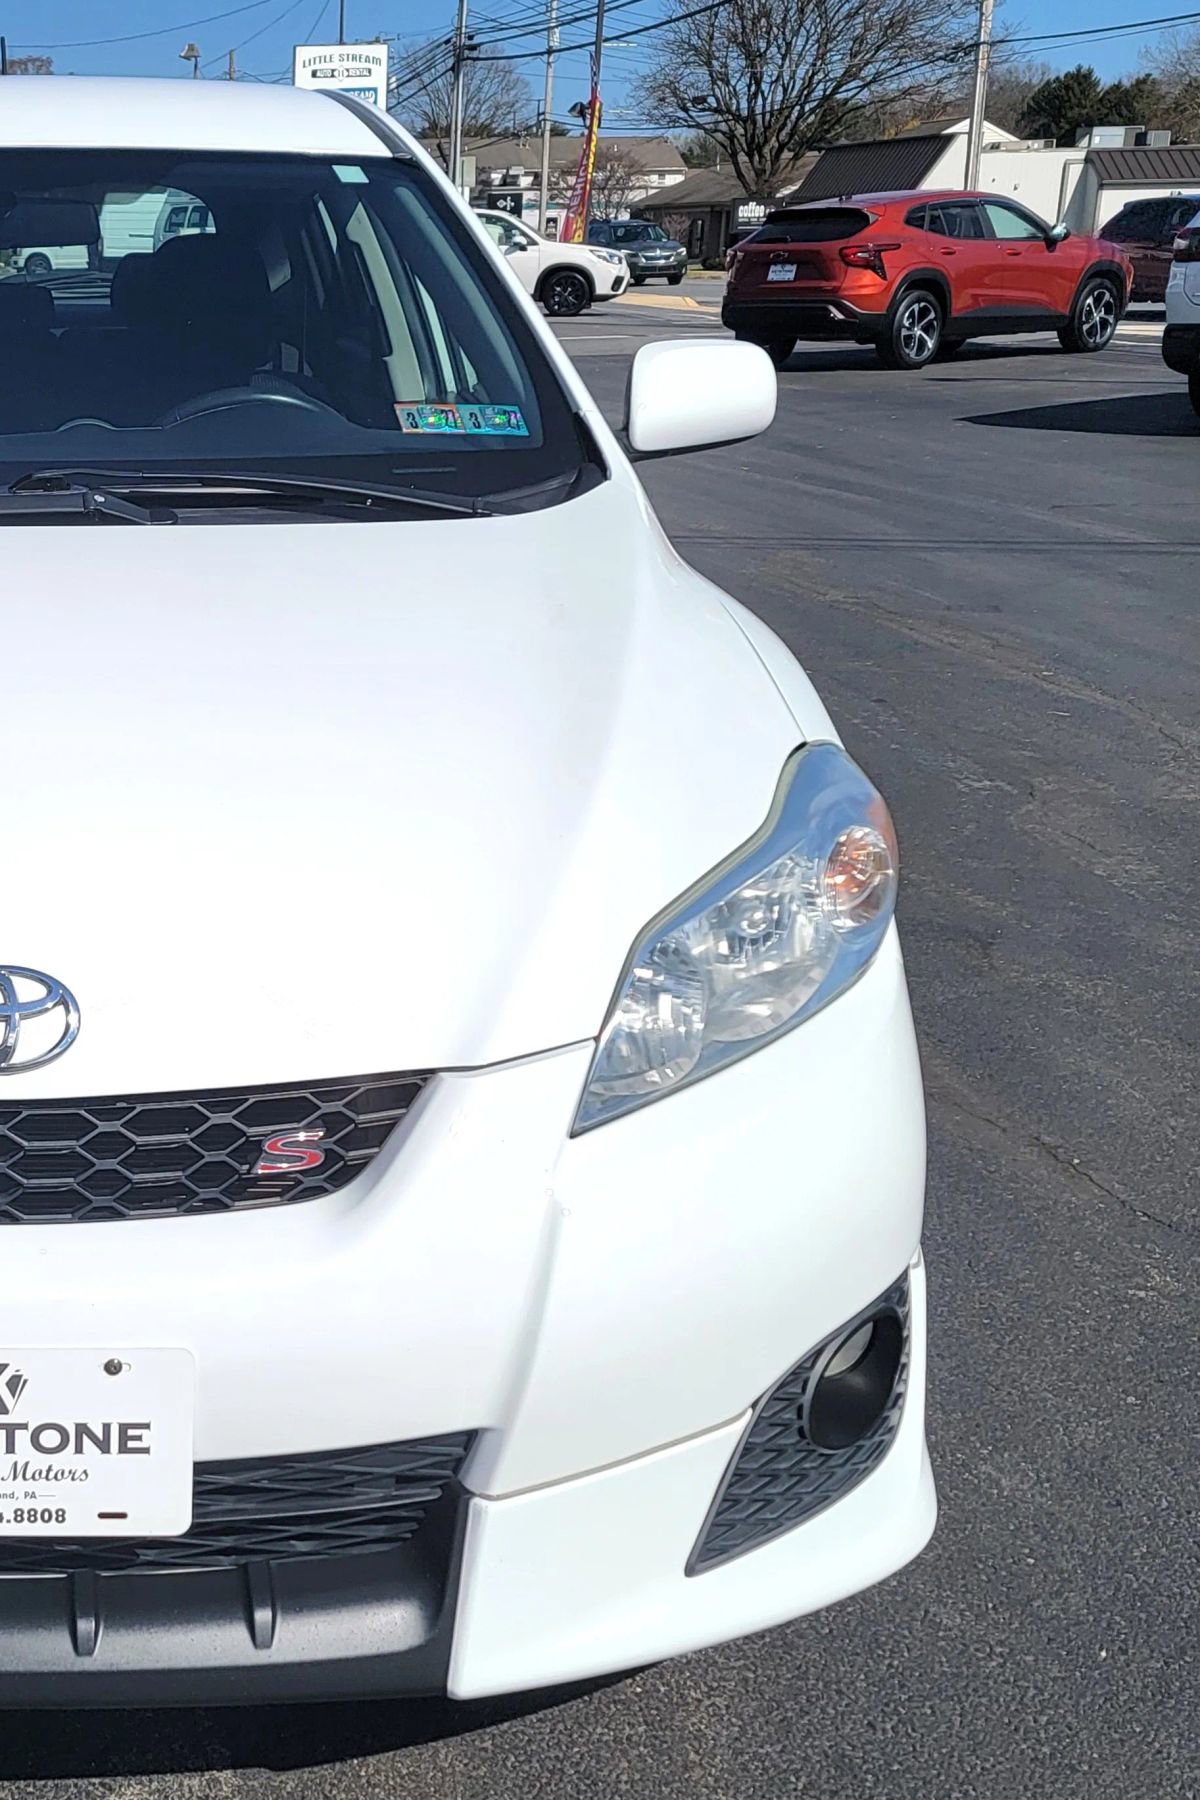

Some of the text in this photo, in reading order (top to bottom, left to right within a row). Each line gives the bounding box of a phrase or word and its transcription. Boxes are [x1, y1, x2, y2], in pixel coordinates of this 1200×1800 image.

[302, 53, 382, 68] LITTLE STREAM
[738, 201, 765, 217] coffee
[406, 411, 419, 429] 3
[469, 411, 481, 429] 3
[254, 1129, 326, 1174] S
[0, 1460, 90, 1483] Motors
[24, 1491, 37, 1500] PA
